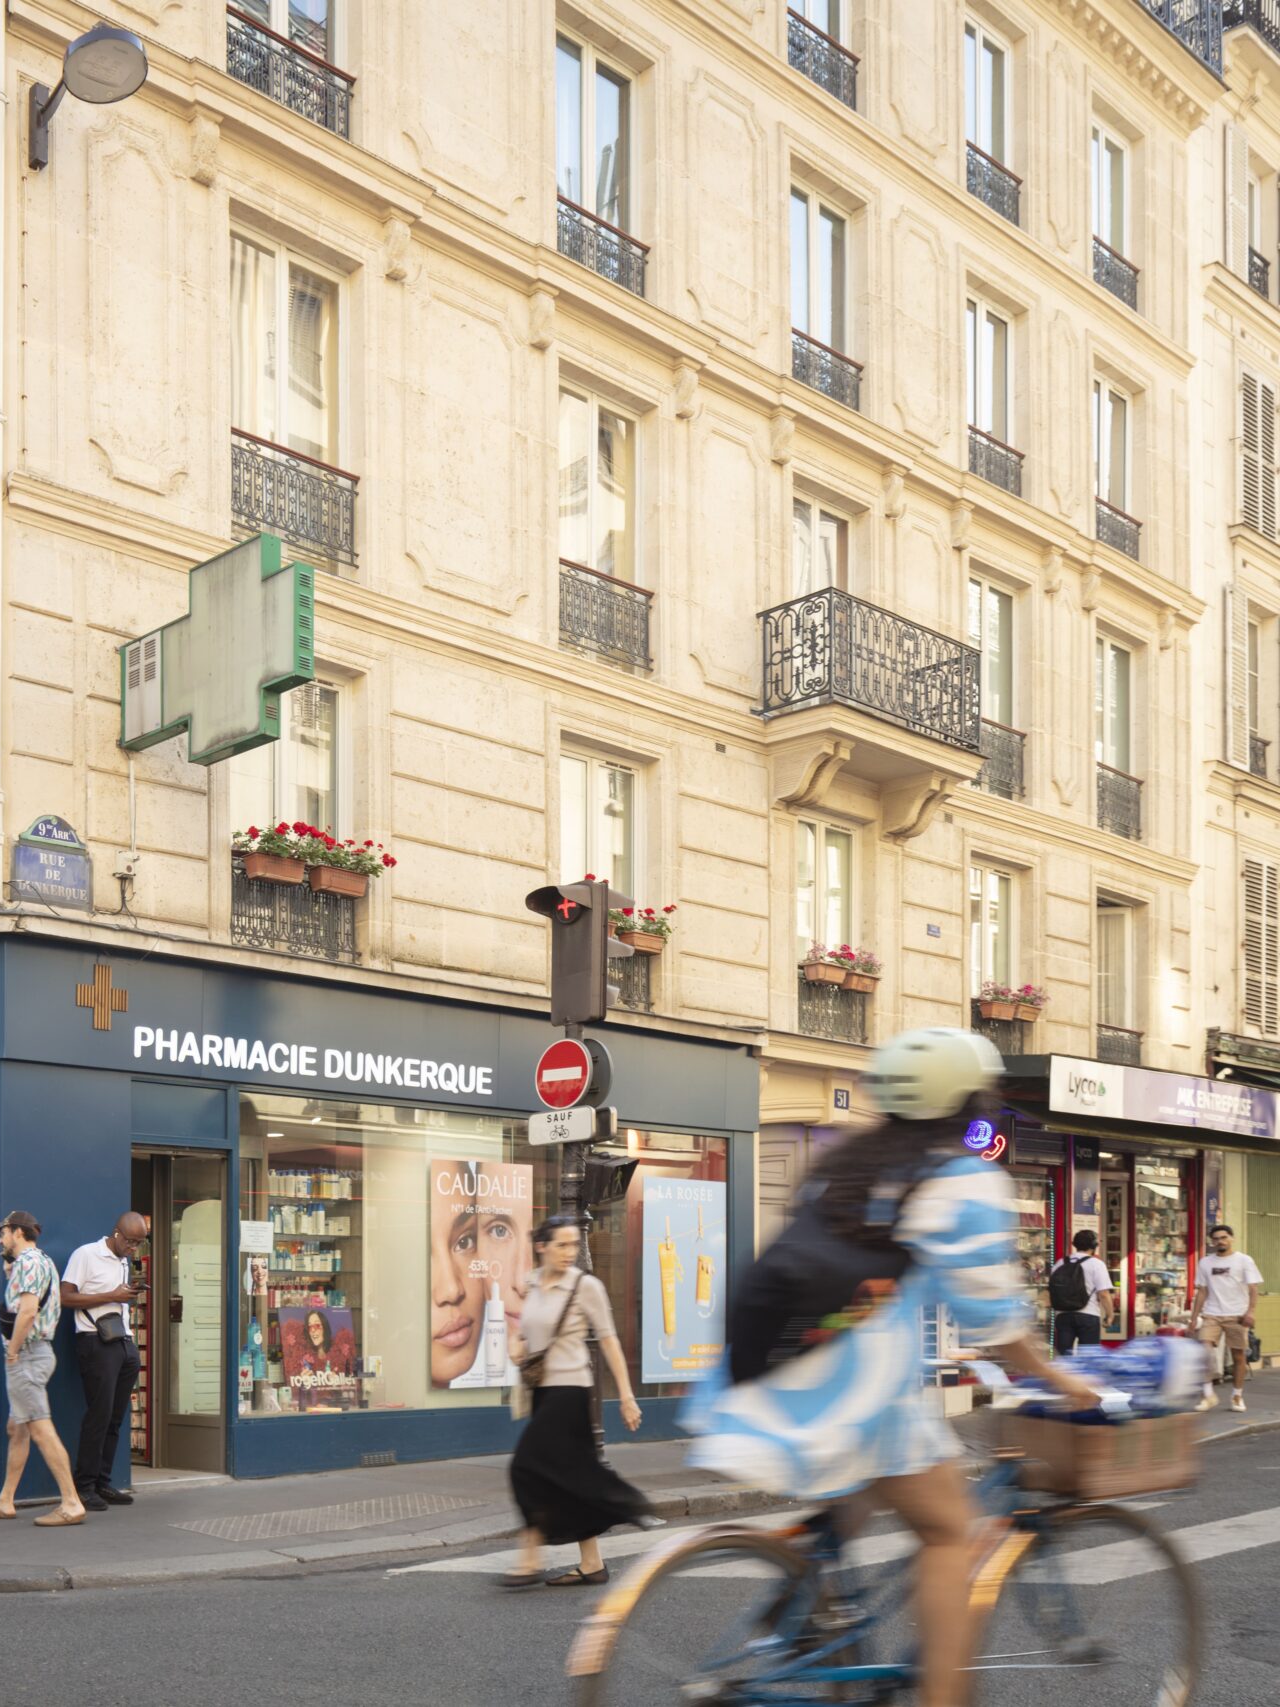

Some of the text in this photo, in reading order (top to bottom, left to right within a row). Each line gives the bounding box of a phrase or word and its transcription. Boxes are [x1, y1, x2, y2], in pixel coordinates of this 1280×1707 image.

[39, 852, 65, 867] RUE
[45, 869, 61, 881] DE
[133, 1026, 493, 1095] PHARMACIE DUNKERQUE
[1069, 1071, 1096, 1098] Lyca
[836, 1091, 847, 1108] 51
[547, 1111, 573, 1123] SAUF
[658, 1185, 672, 1199] LA
[465, 1204, 474, 1214] de
